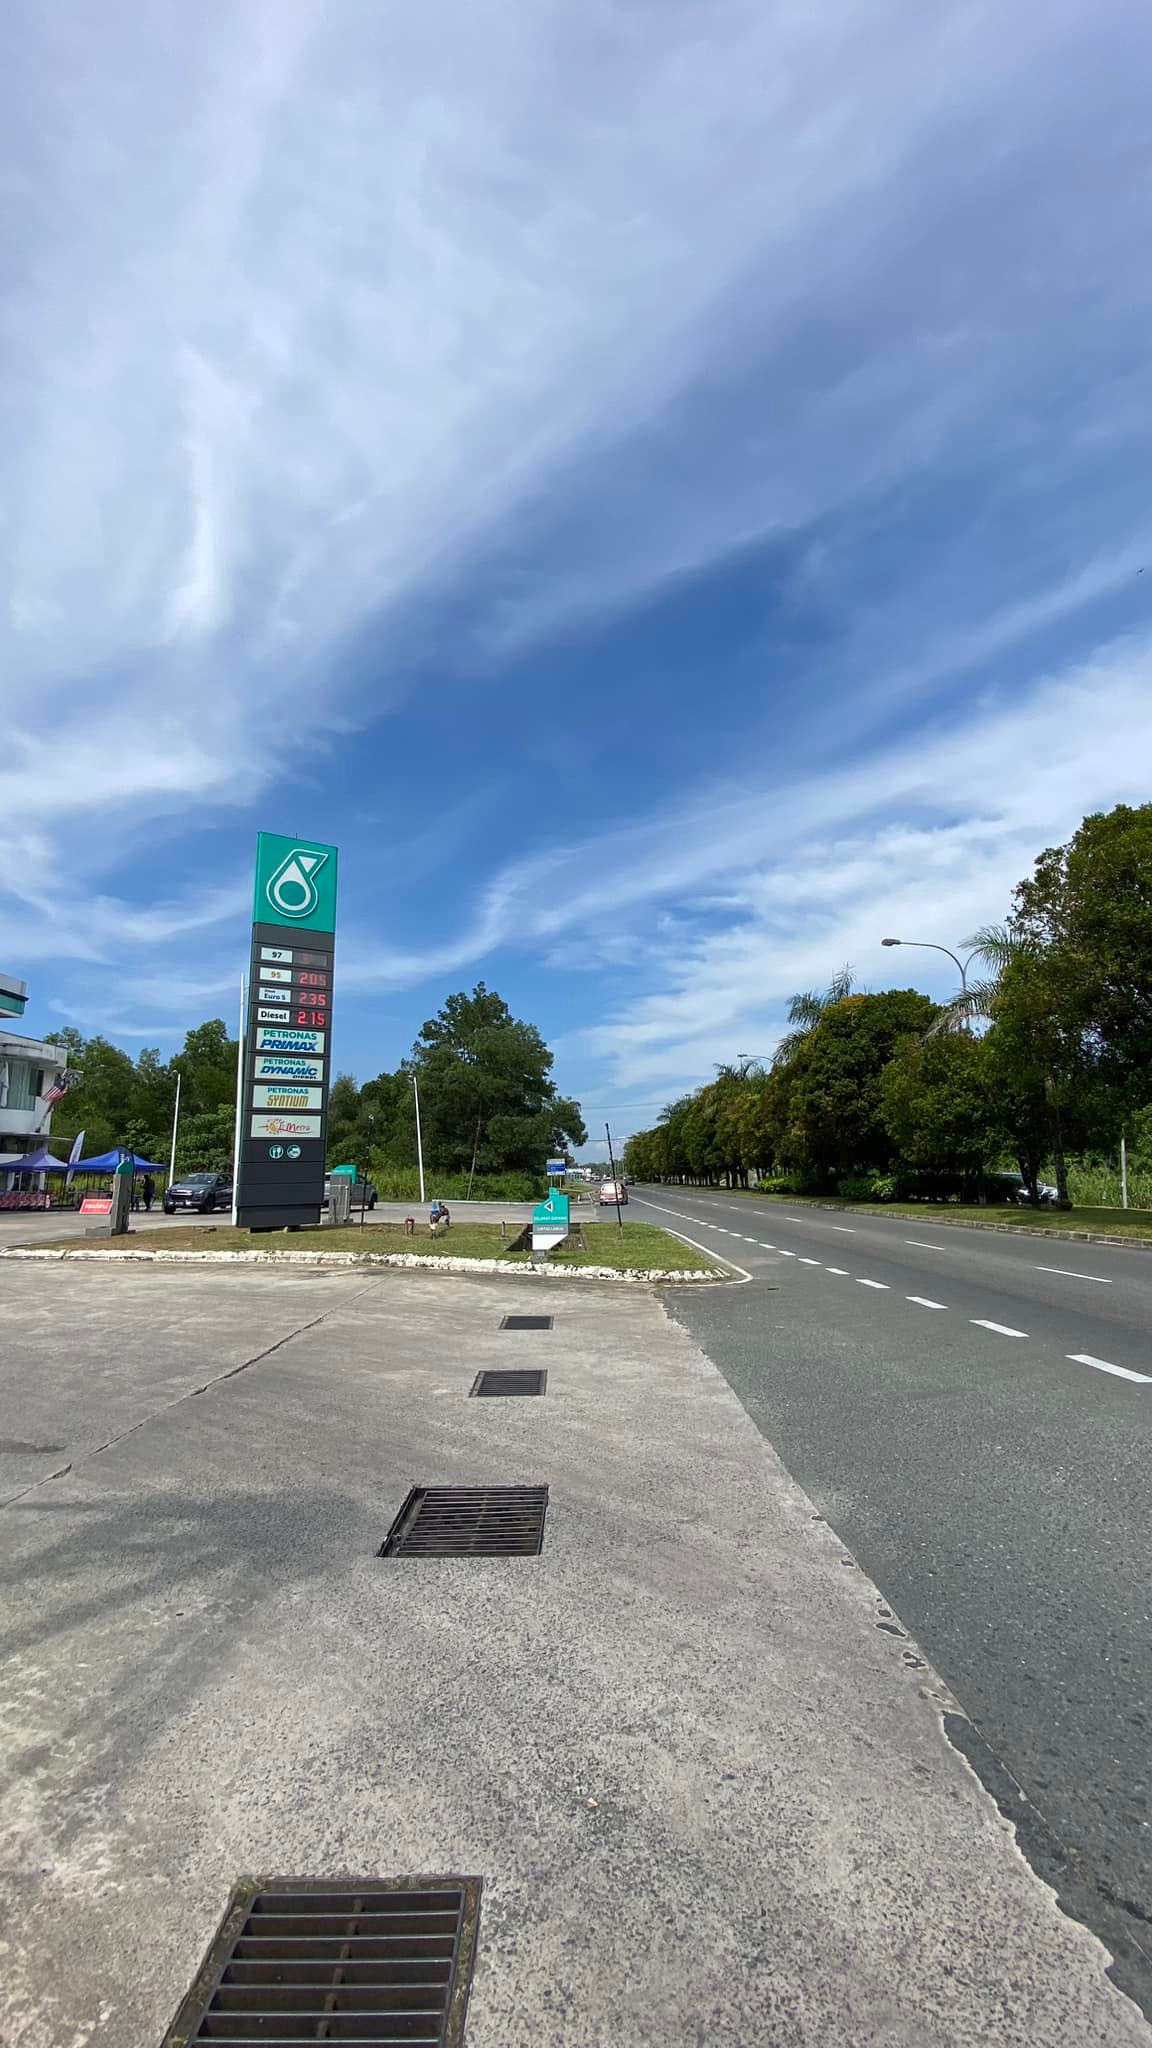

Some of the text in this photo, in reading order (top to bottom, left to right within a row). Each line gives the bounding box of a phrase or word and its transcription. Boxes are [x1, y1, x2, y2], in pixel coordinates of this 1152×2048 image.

[271, 951, 283, 959] 97
[260, 1010, 287, 1020] Diesel
[263, 1029, 317, 1040] PETRONAS
[260, 1039, 319, 1051] PRIMAX
[263, 1058, 306, 1066] PETRONAS
[260, 1064, 318, 1075] DYNAMIC
[266, 1095, 309, 1107] SYNTIUM
